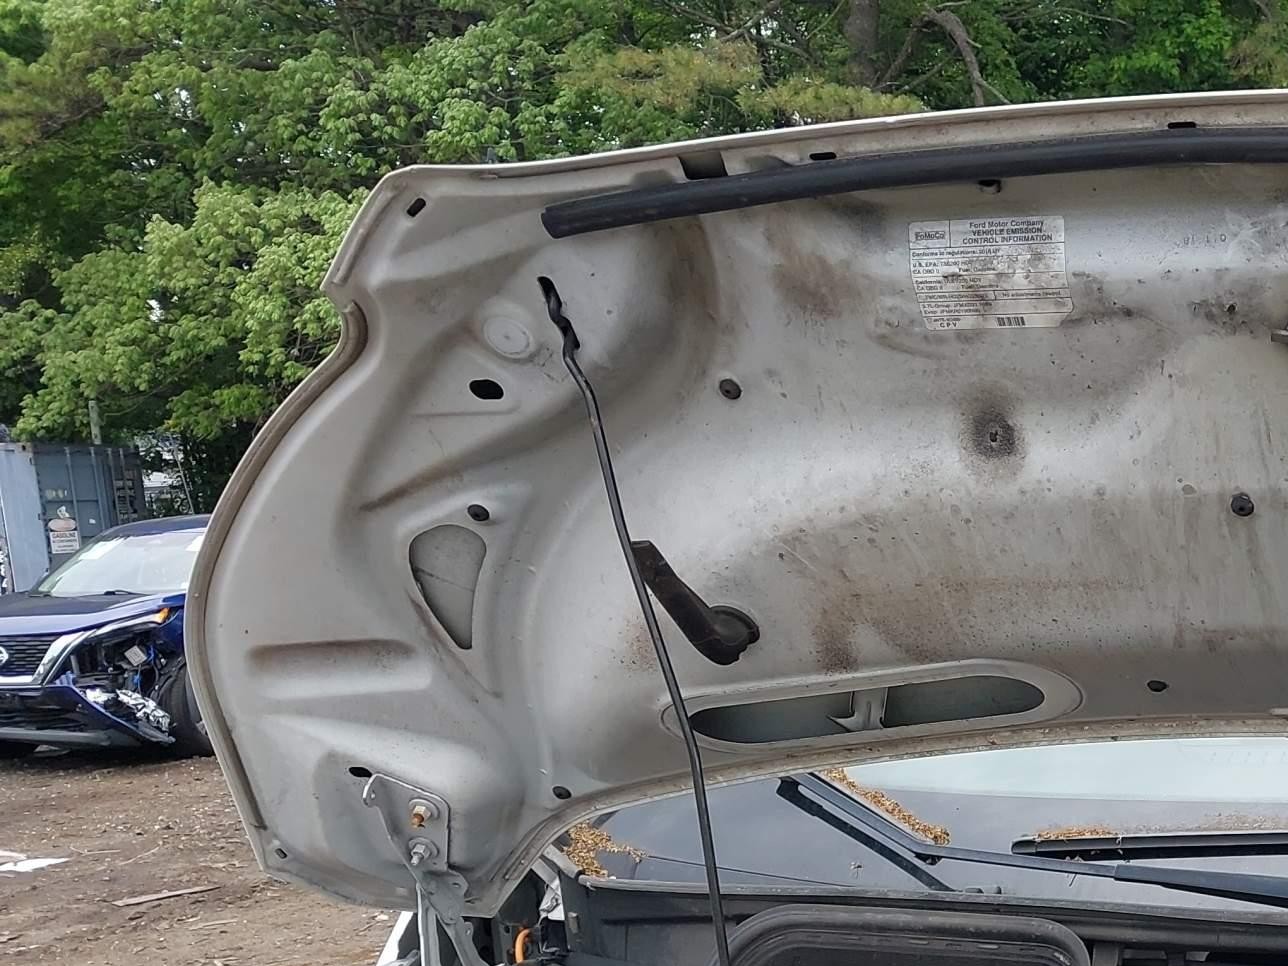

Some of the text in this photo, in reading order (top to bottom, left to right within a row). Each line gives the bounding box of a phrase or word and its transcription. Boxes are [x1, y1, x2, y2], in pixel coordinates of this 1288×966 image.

[1010, 220, 1044, 229] Company
[914, 231, 946, 241] FoMoCo
[972, 227, 1043, 237] VEHICLE EMISSION
[962, 234, 1053, 245] CONTROL INFORMATION
